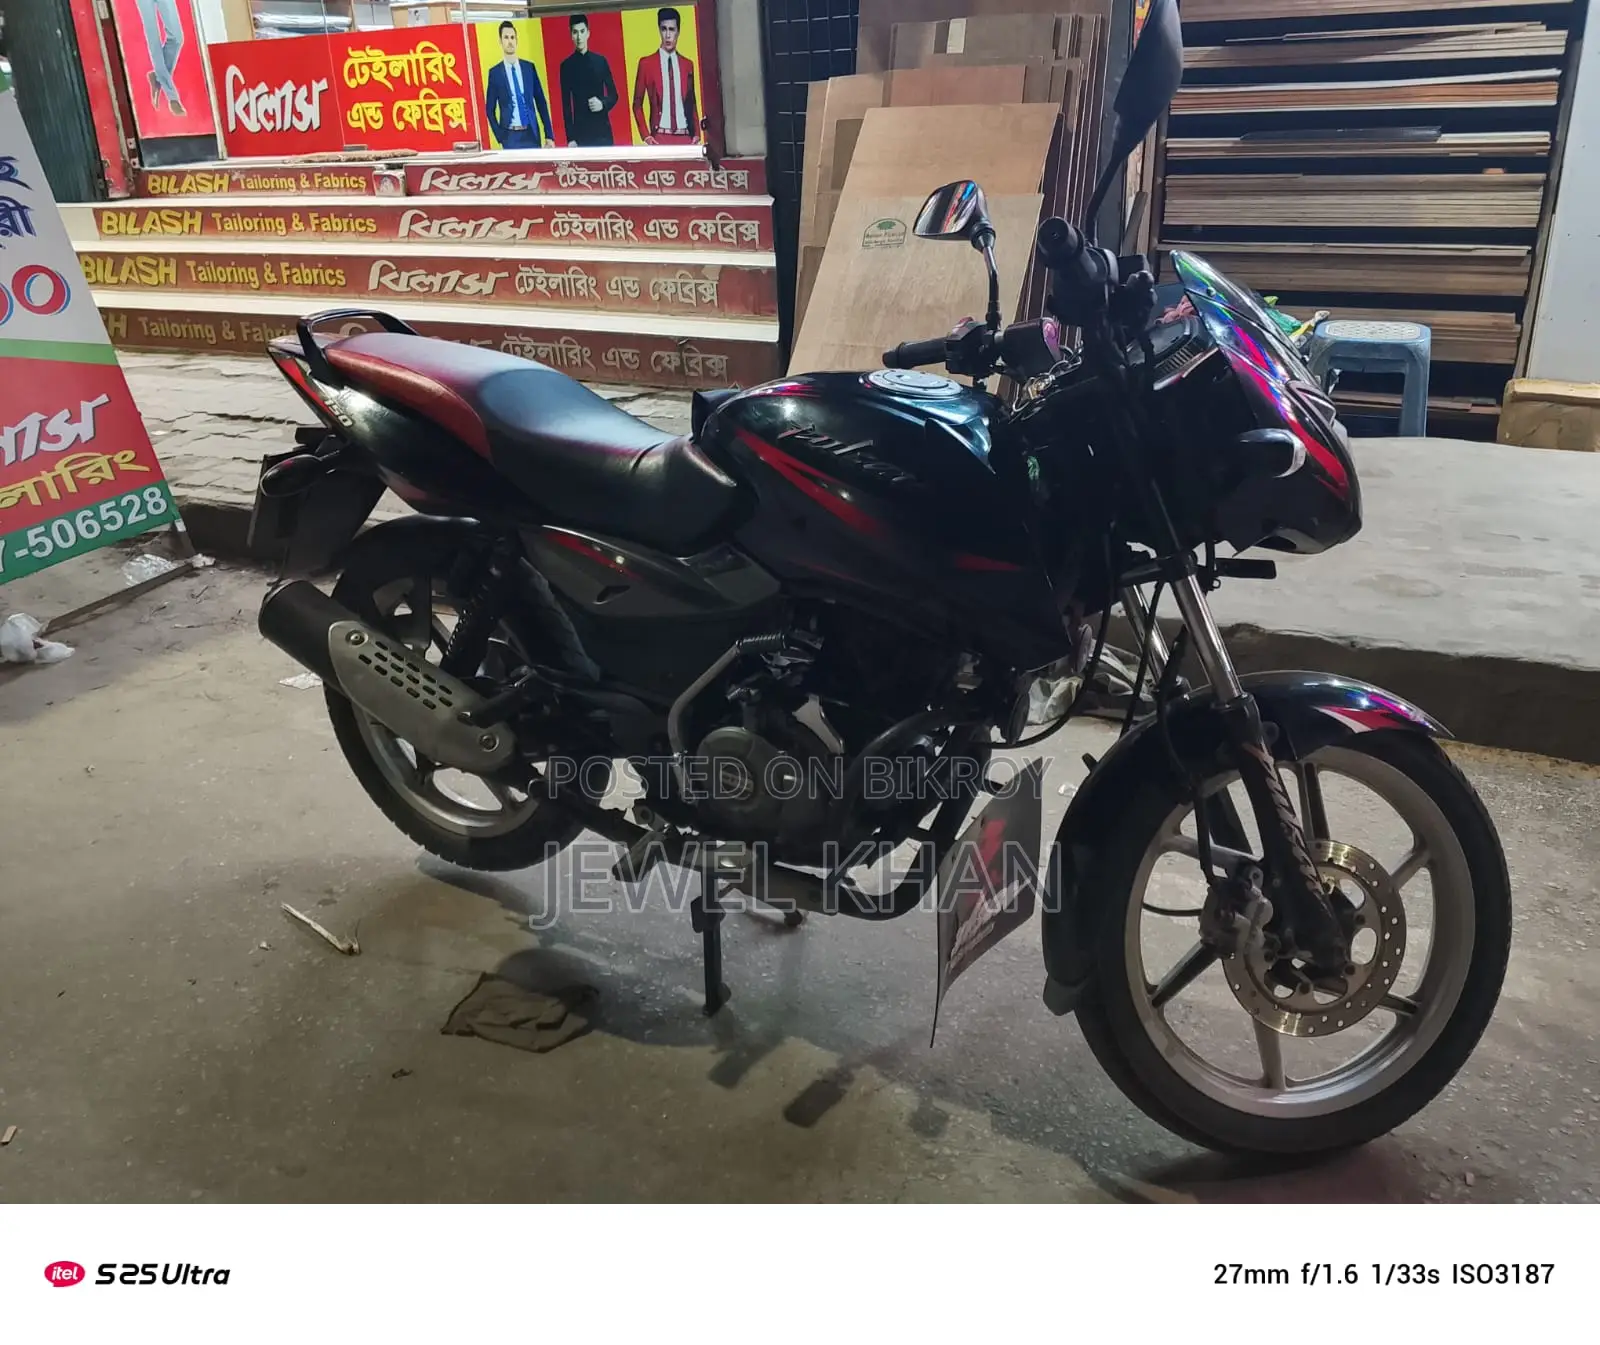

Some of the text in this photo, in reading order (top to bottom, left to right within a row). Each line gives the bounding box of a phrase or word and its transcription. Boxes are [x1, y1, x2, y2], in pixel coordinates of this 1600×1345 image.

[343, 40, 463, 92] টেইলারিং
[225, 64, 329, 134] বিলাস
[147, 171, 367, 194] BILASH Tailoring & Fabrics
[419, 167, 554, 192] বিলাস
[101, 207, 378, 236] BILASH Tailoring & Fabrics
[399, 209, 545, 241] বিলাস
[550, 210, 640, 243] টেইলারিং
[80, 254, 347, 289] BILASH Tailoring & Fabrics
[368, 260, 510, 296] বিলাস
[515, 264, 603, 302] টেইলারিং
[138, 316, 217, 345] Tailoring
[222, 320, 236, 341] &
